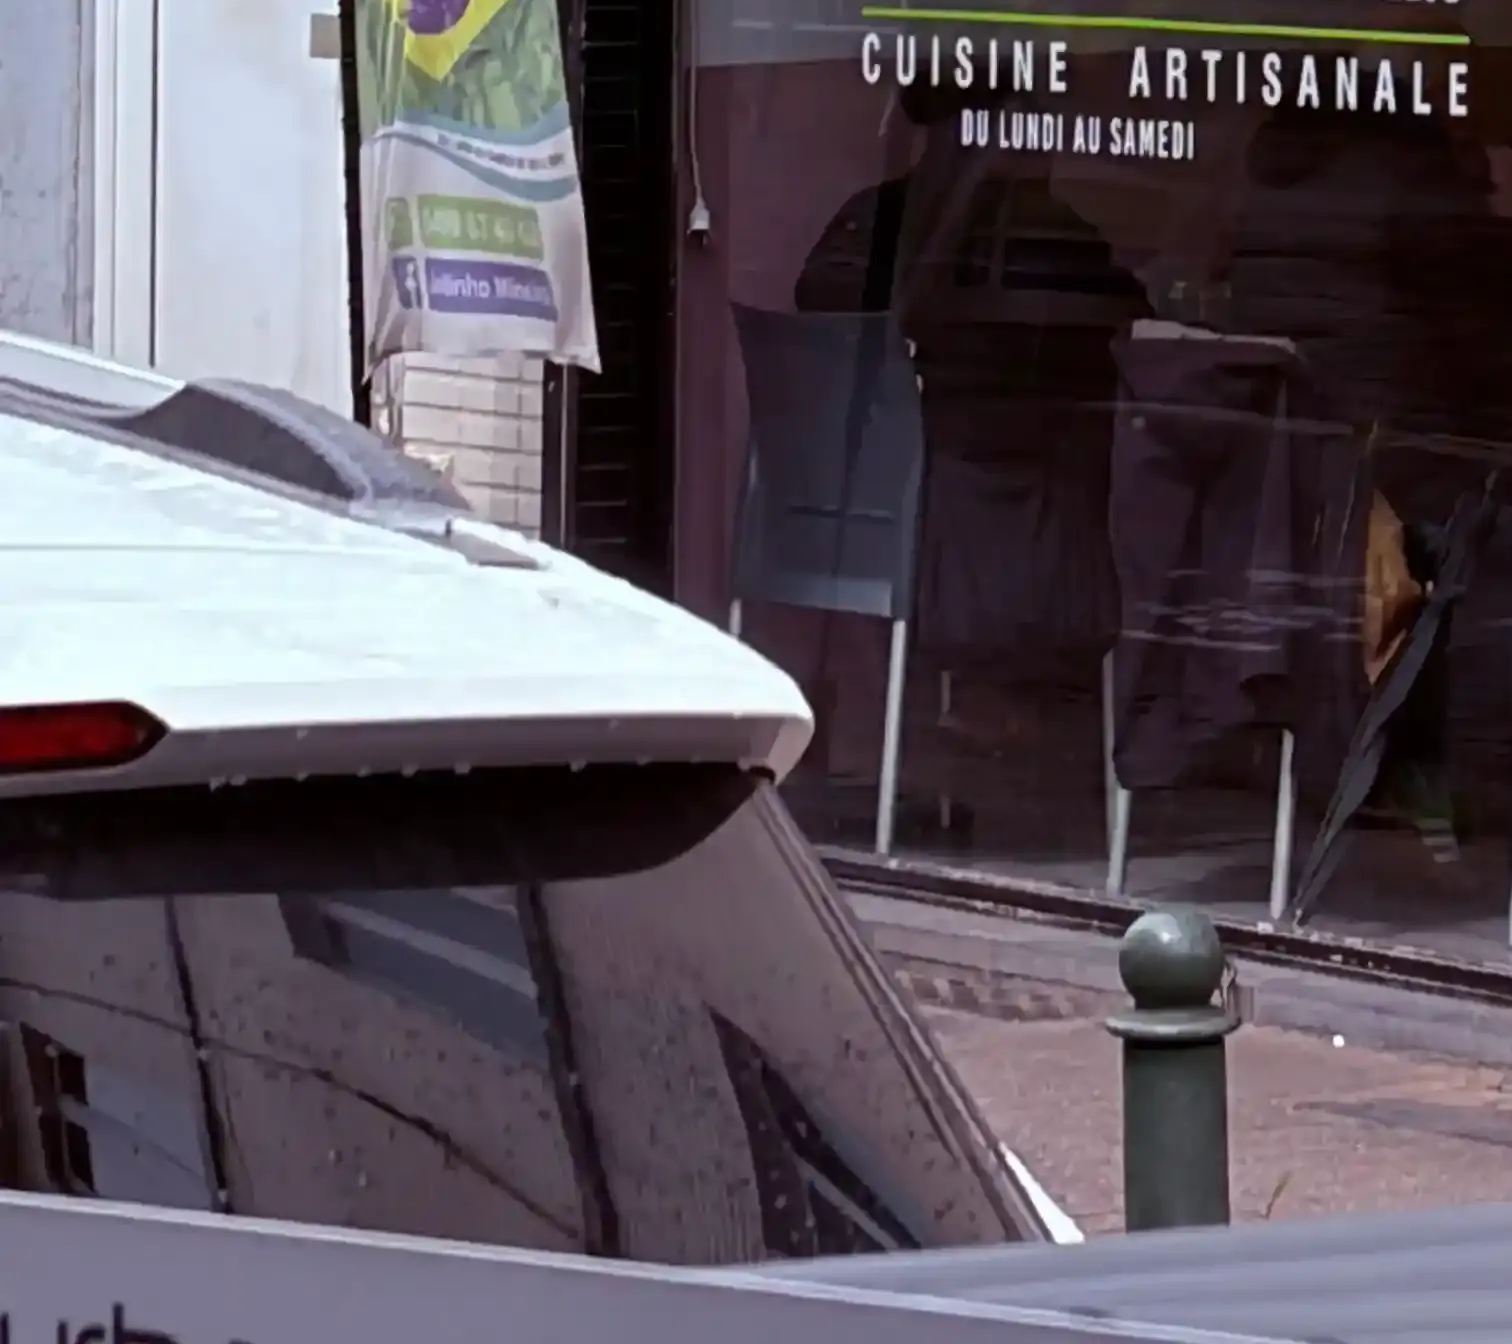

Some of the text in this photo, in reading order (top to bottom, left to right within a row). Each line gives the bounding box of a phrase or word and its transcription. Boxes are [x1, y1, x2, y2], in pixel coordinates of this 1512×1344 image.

[861, 32, 1470, 117] CUISINE ARTISANALE
[961, 108, 1195, 160] DU LUNDI AU SAMEDI
